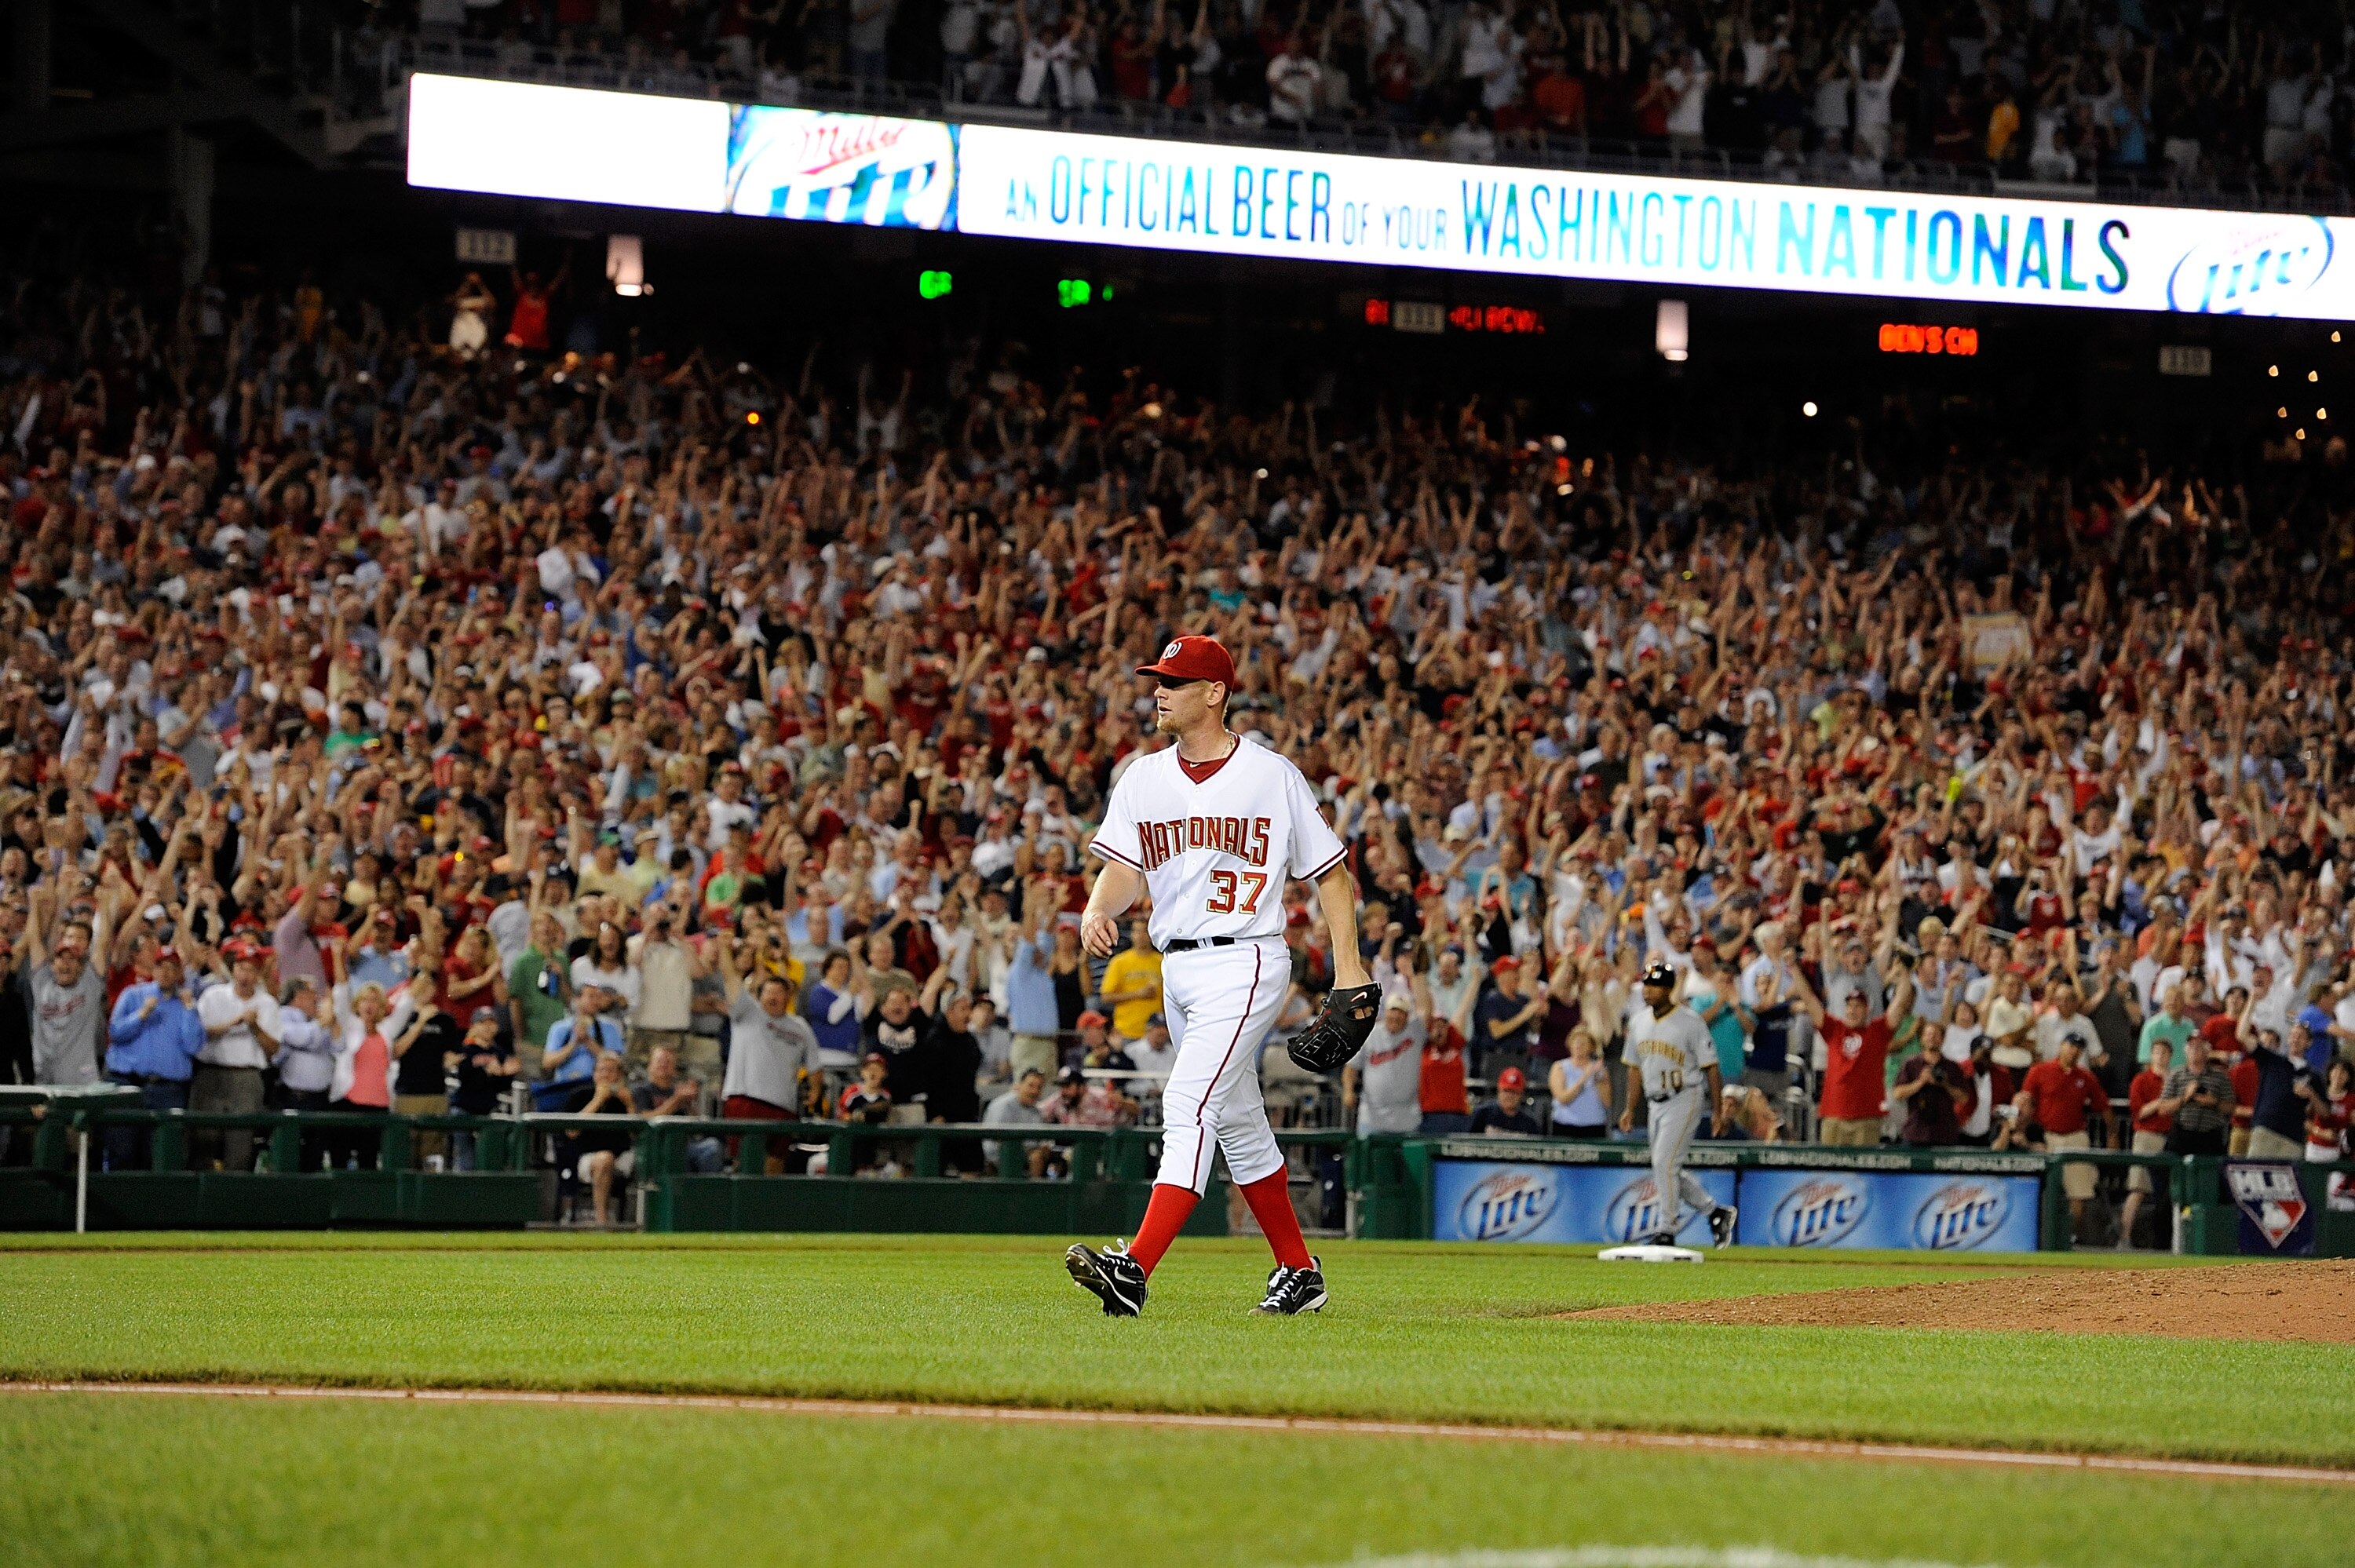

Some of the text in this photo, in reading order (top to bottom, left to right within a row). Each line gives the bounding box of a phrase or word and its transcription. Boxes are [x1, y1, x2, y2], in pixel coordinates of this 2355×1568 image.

[1005, 155, 2130, 295] AN OFFICIAL BEER OF YOUR WASHINGTON NATIONALS
[1137, 816, 1271, 872] NATIONALS
[1207, 870, 1267, 914] 37
[1661, 1070, 1684, 1093] 10
[1477, 1187, 1546, 1241] Lite
[1789, 1195, 1857, 1247] Lite
[1930, 1199, 1998, 1249] Lite
